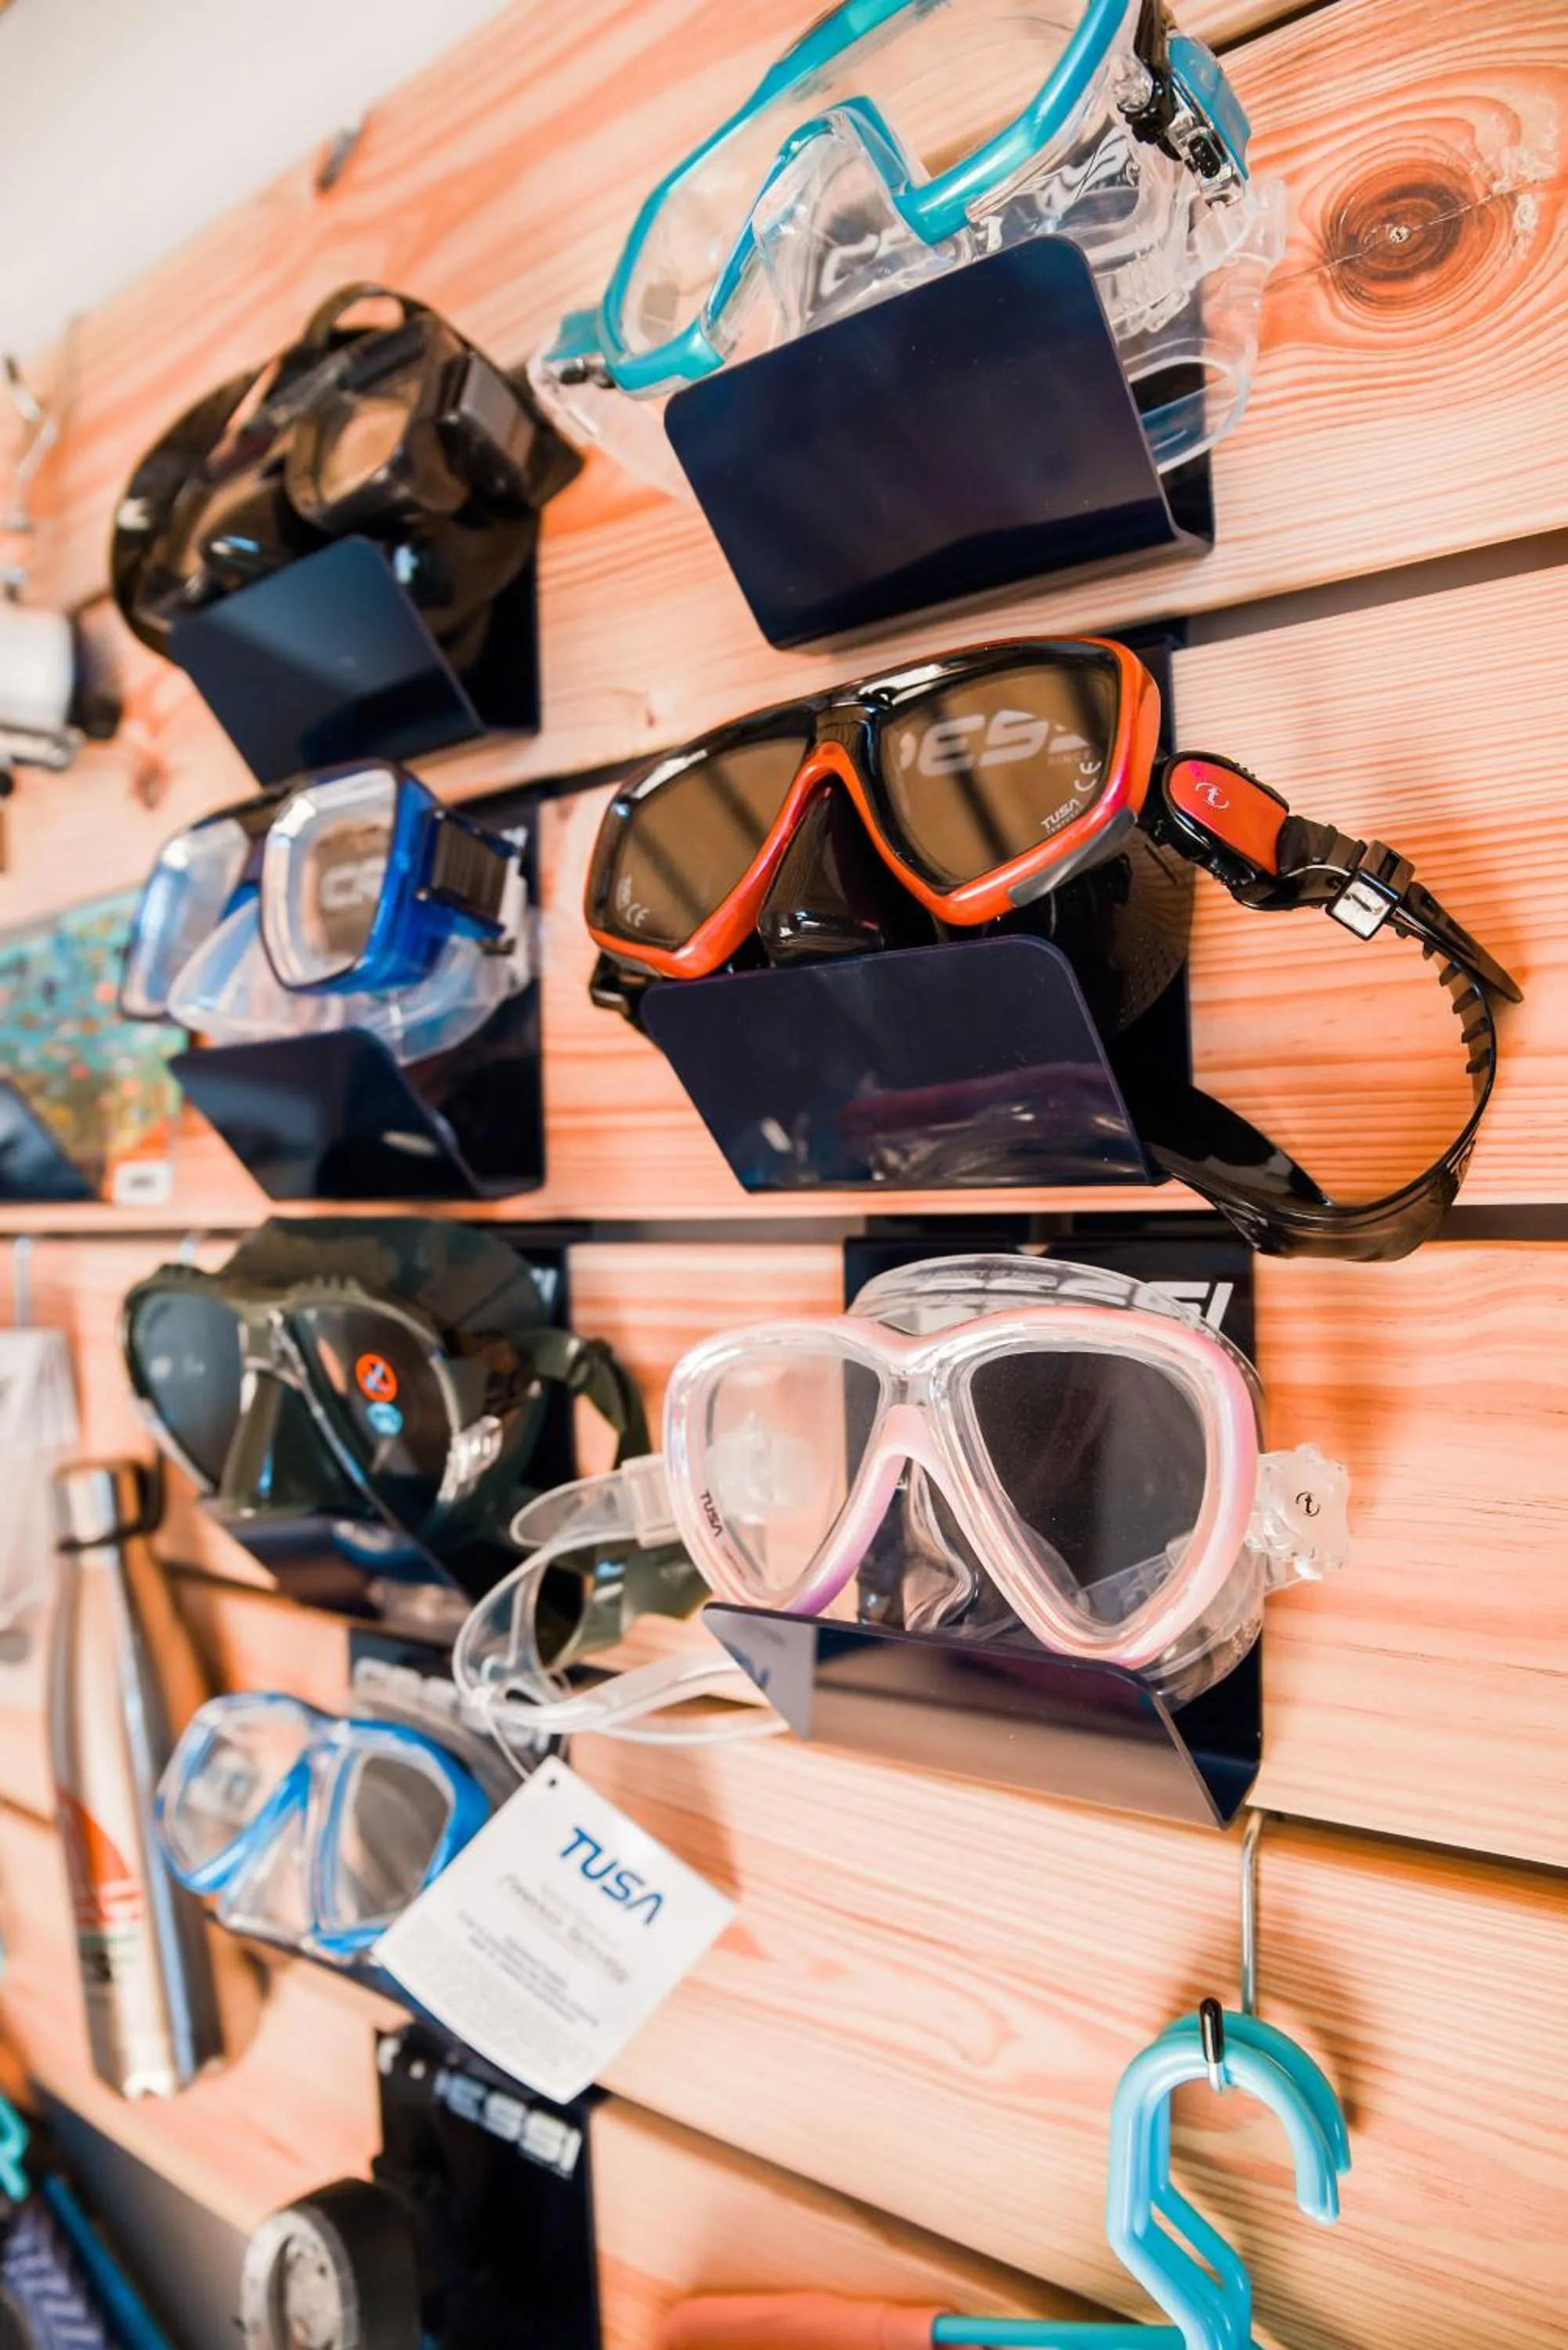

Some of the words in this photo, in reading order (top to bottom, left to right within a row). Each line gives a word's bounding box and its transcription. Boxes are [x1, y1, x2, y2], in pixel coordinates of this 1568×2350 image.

[1040, 797, 1081, 830] TUSA
[699, 1488, 724, 1538] TUSA
[560, 1826, 663, 1925] TUSA
